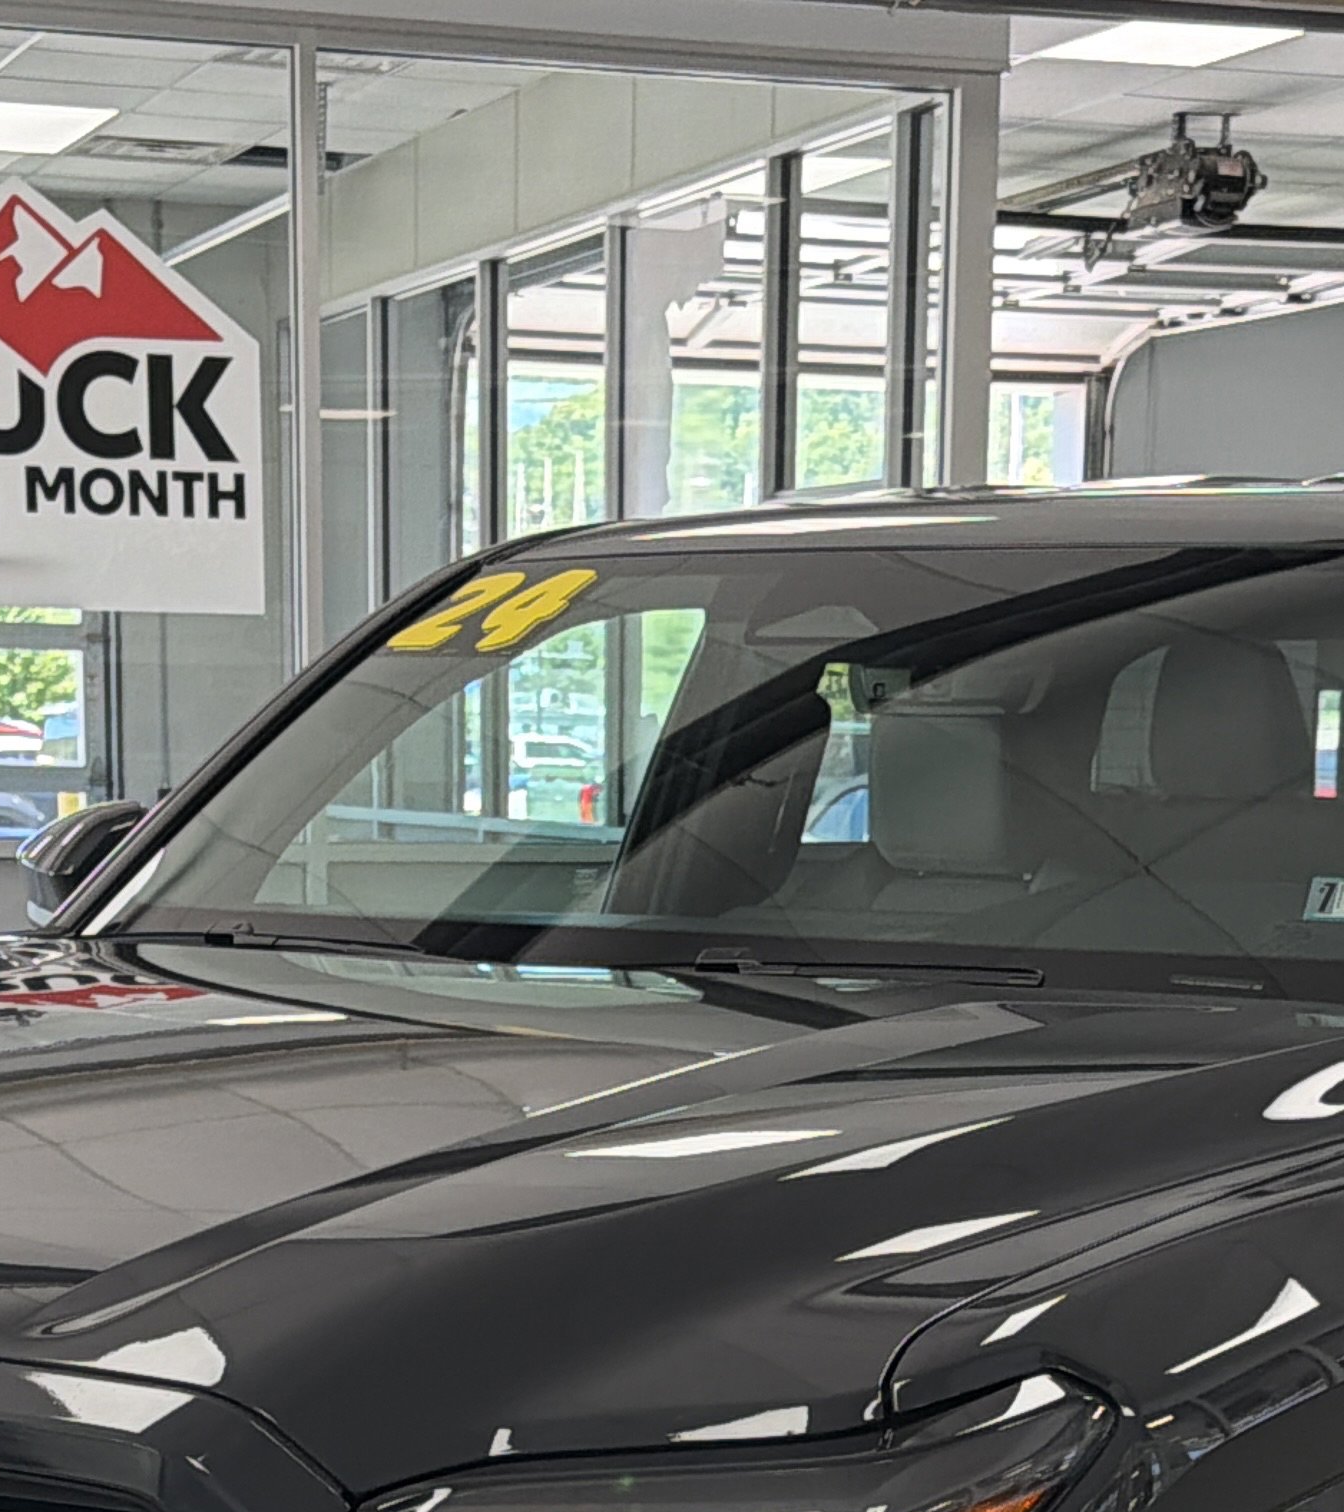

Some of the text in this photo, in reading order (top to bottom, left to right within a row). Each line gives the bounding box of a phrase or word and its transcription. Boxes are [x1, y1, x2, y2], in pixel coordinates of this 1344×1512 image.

[24, 465, 247, 520] MONTH
[386, 568, 599, 653] 24
[1317, 882, 1338, 914] 7
